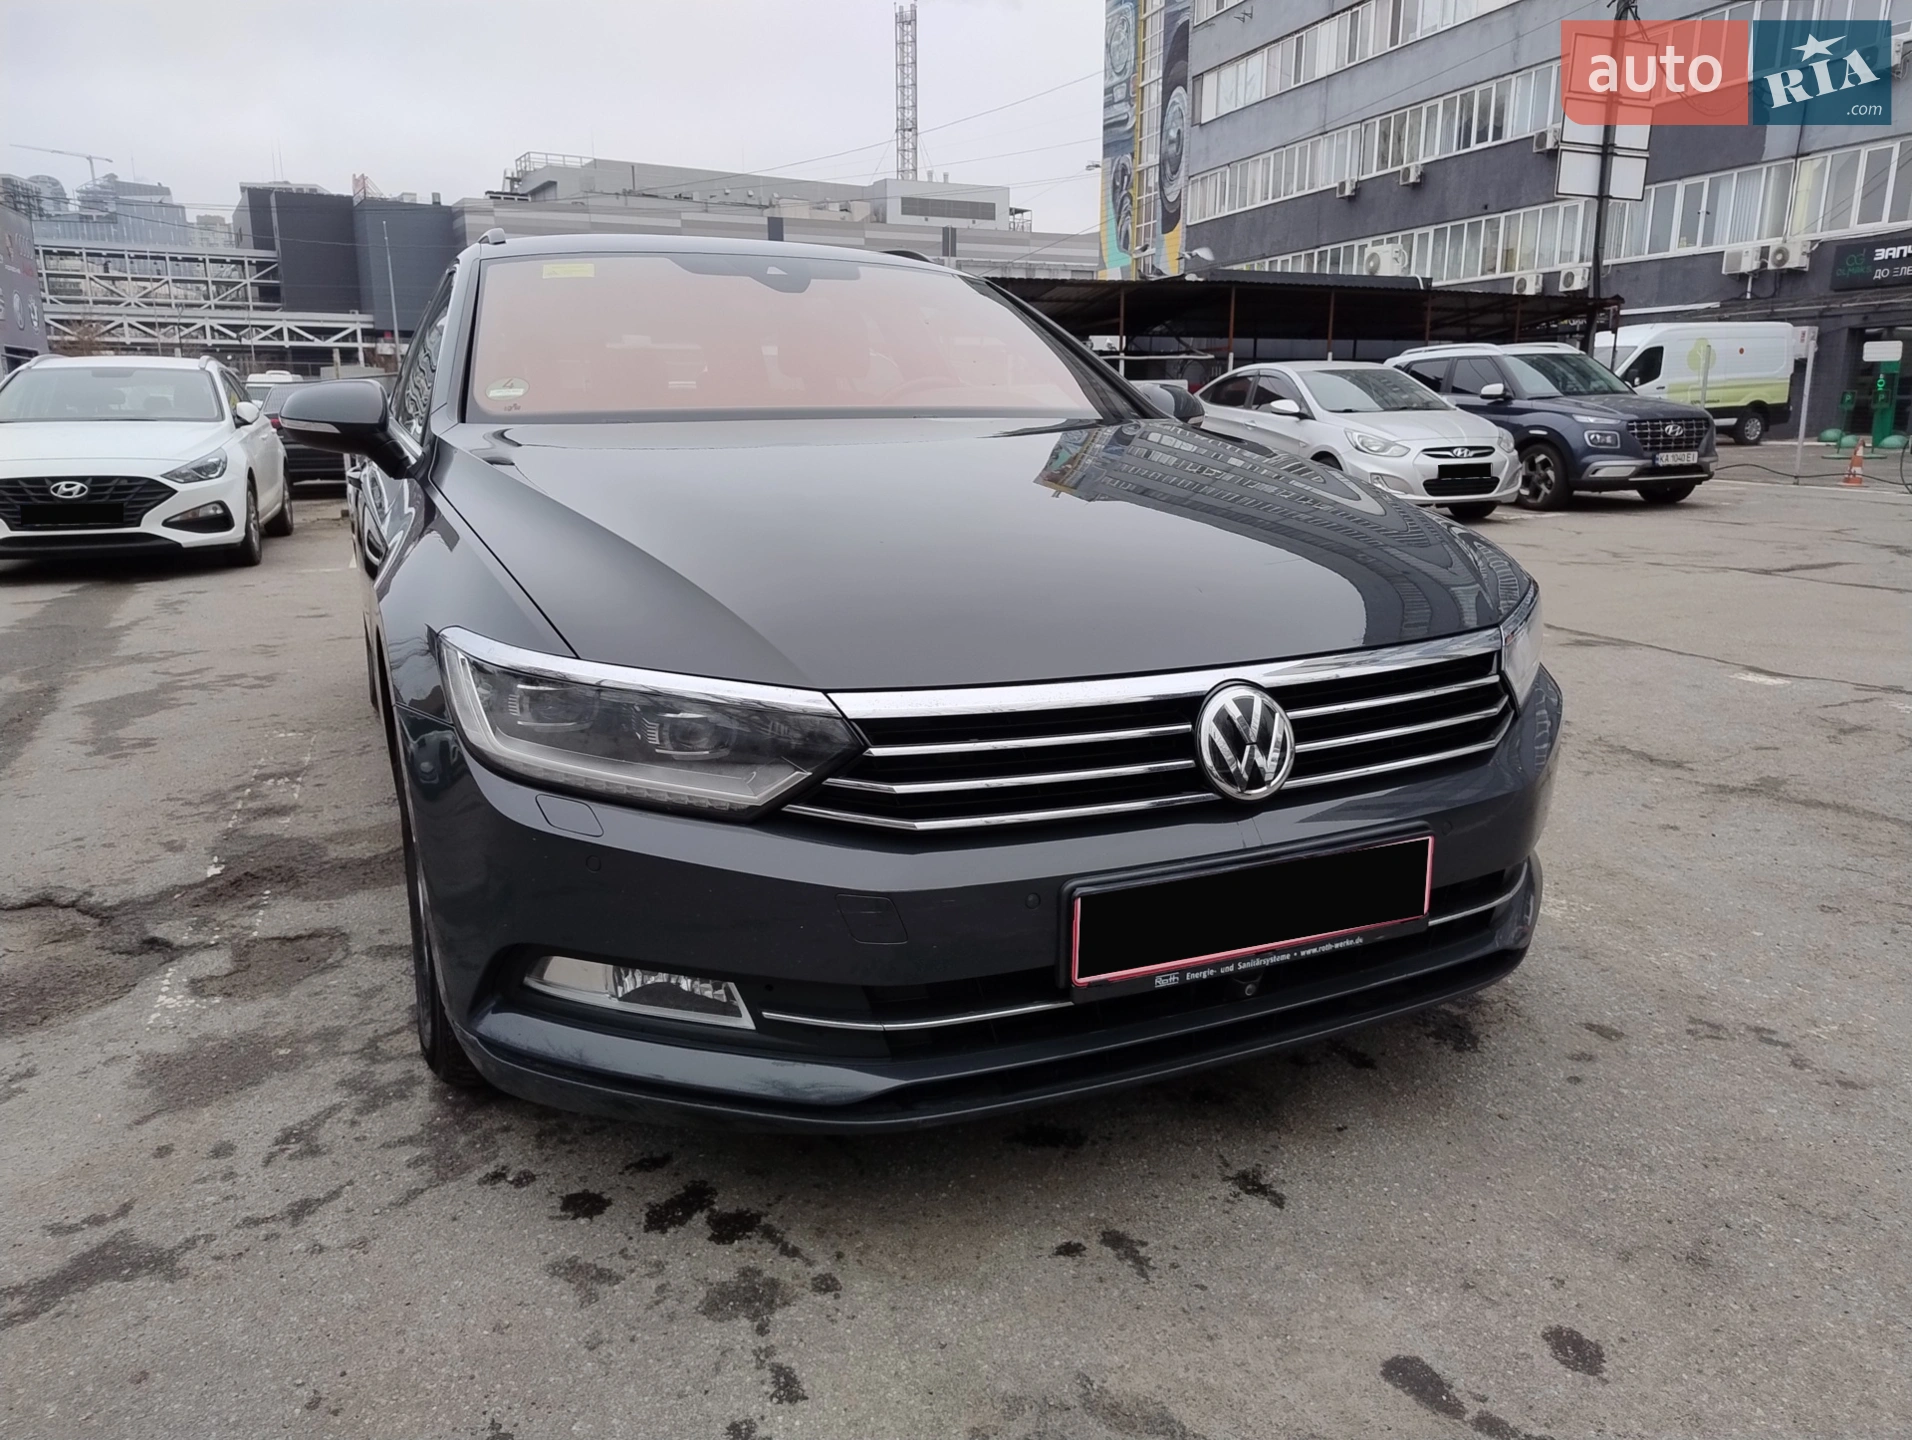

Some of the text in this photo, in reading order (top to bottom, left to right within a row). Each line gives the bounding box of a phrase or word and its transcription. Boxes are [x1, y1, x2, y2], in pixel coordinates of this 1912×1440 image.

[1186, 968, 1217, 980] Energie-
[1220, 964, 1234, 973] und
[1237, 952, 1291, 970] Sanitärsysteme
[1300, 936, 1364, 956] www.roth-werke.de
